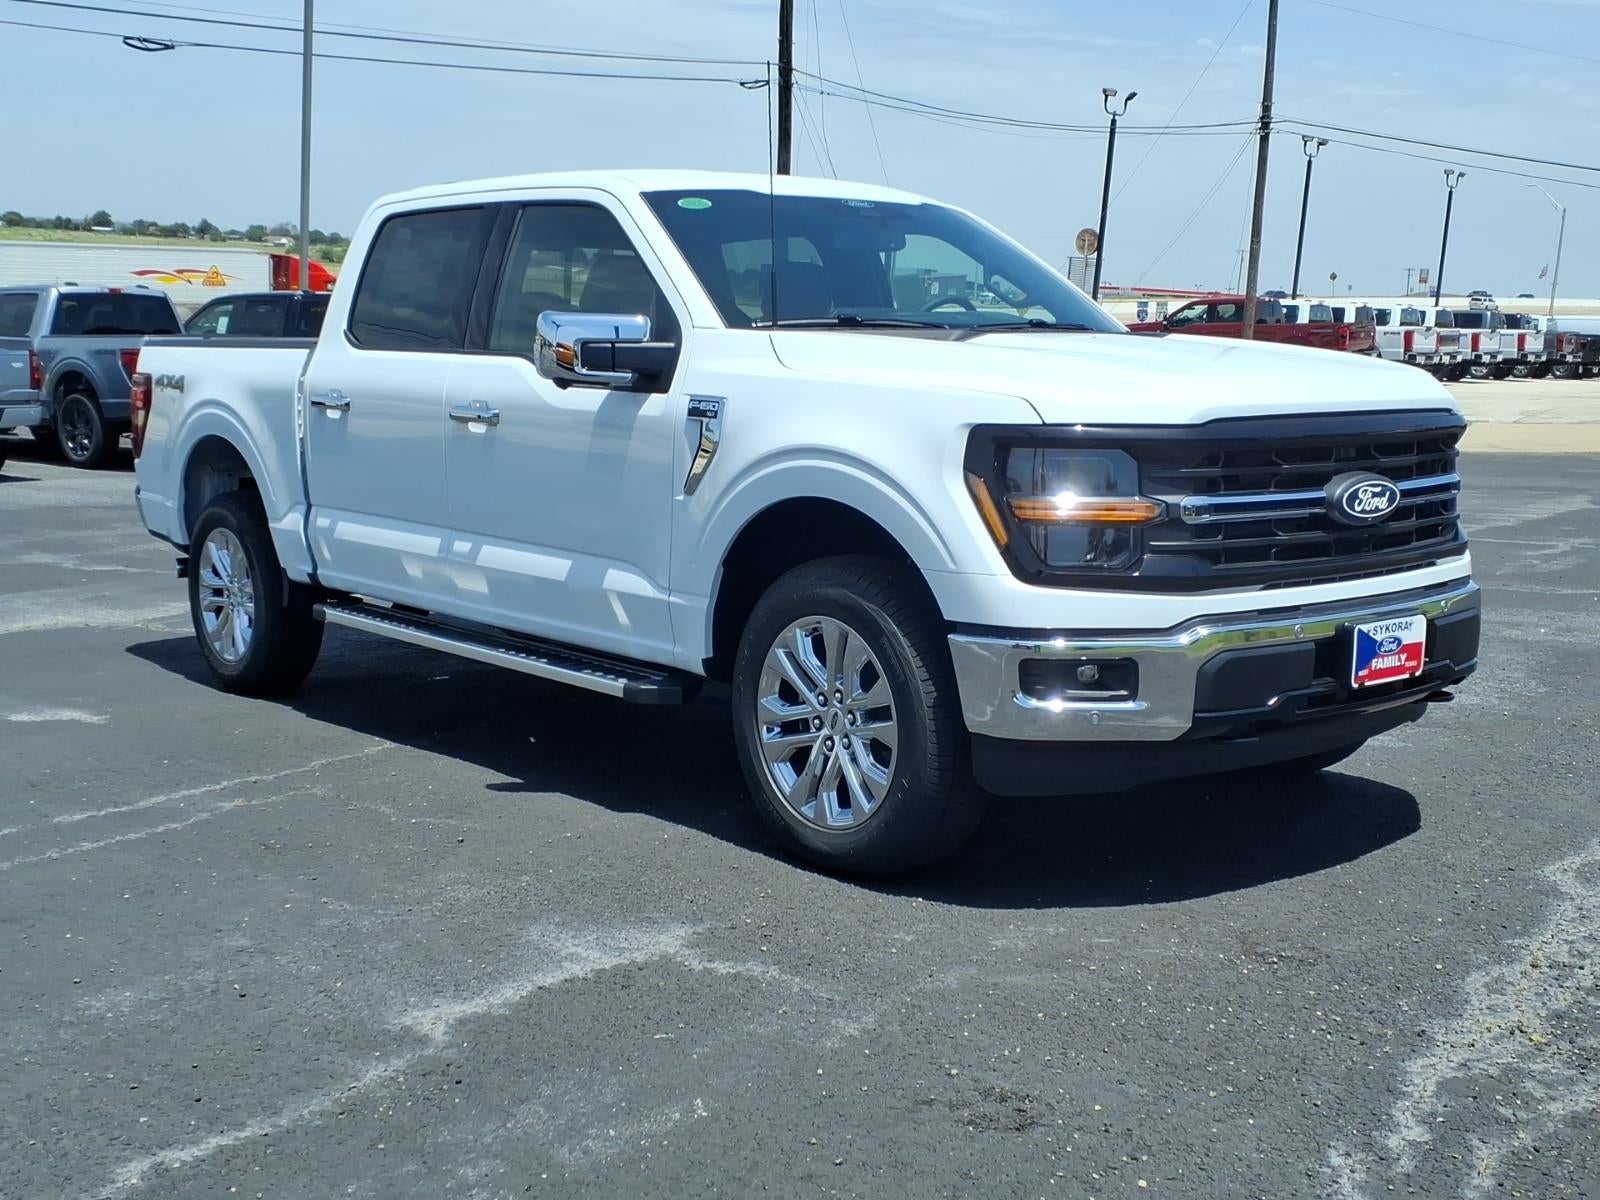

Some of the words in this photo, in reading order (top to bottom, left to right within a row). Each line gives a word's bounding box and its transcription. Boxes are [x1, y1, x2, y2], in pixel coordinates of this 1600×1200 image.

[1355, 486, 1390, 512] Ford
[1372, 621, 1410, 636] SYKORA
[1381, 638, 1397, 652] Ford
[1371, 653, 1407, 670] FAMILY
